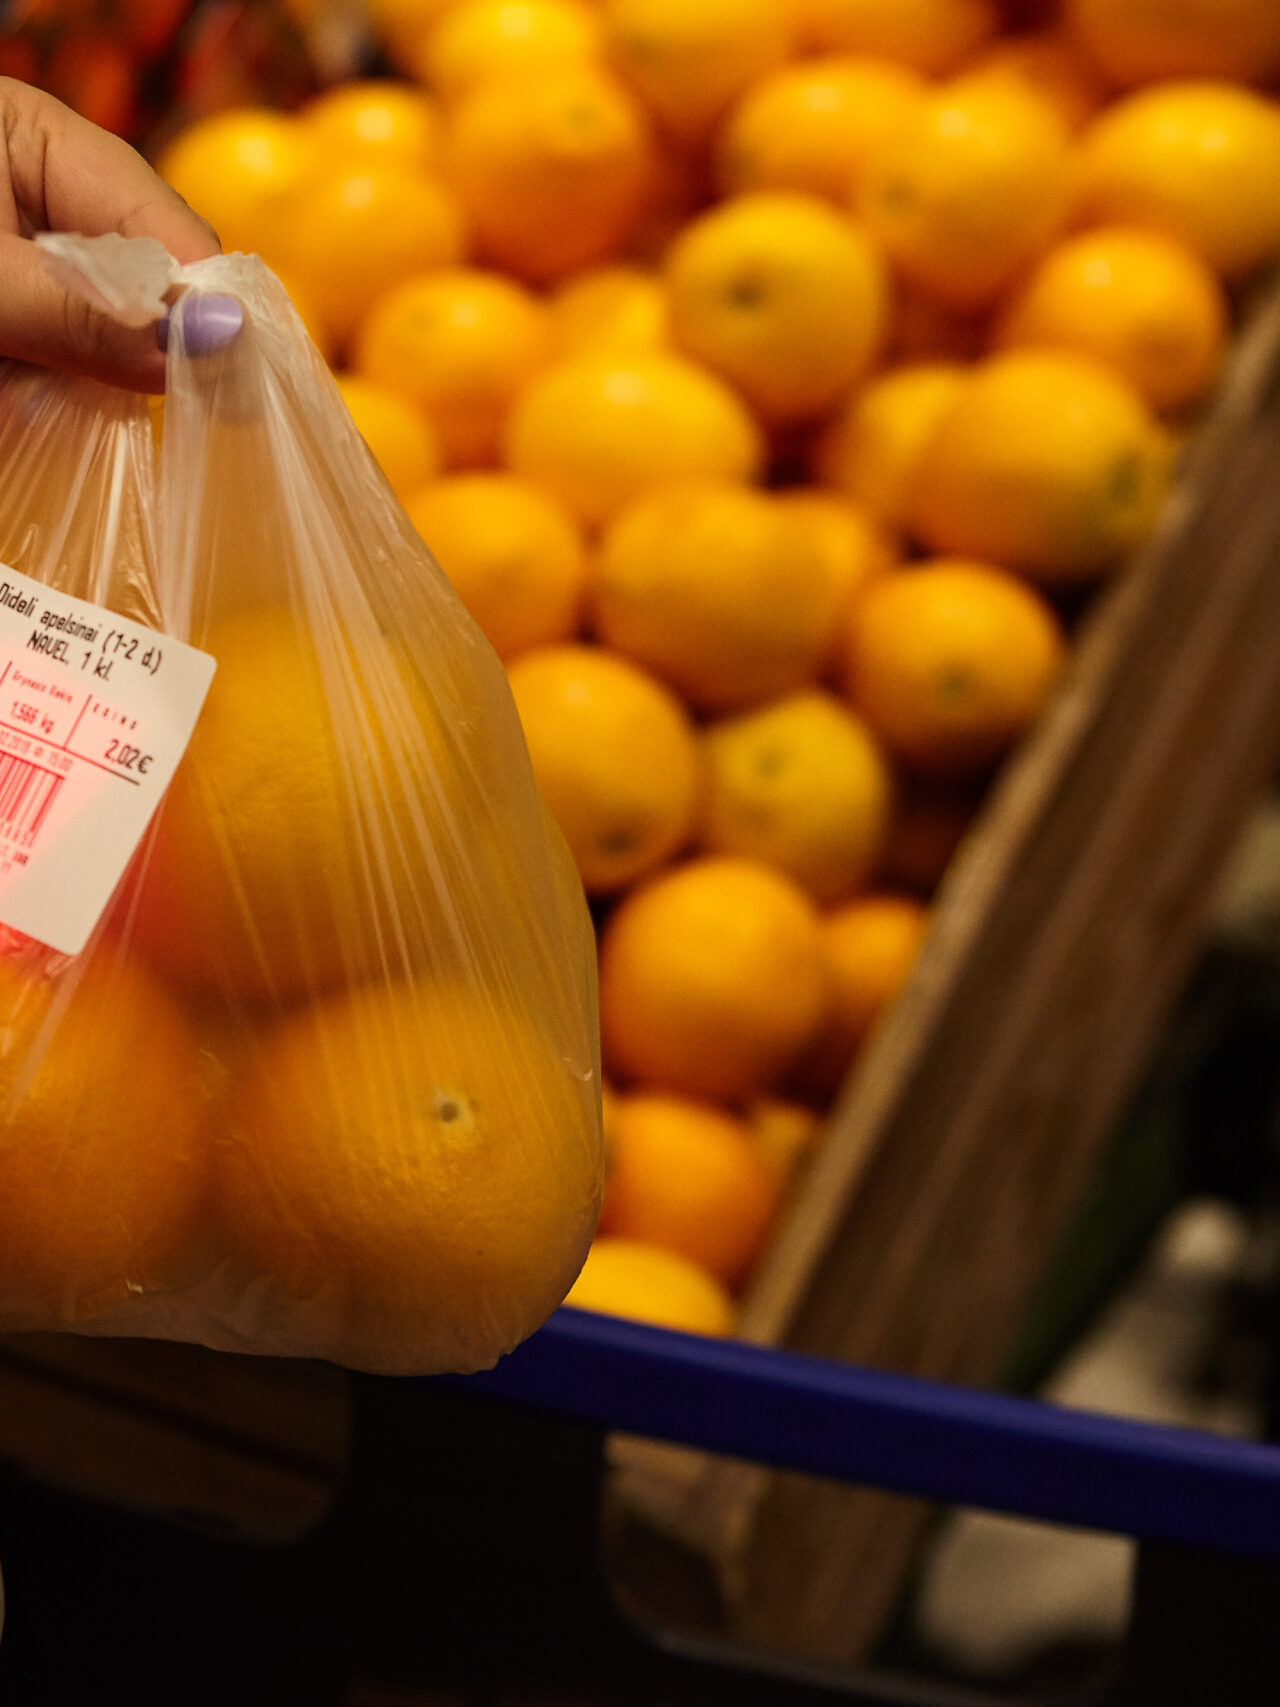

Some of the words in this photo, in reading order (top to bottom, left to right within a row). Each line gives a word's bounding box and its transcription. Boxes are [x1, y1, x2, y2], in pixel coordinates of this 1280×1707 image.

[39, 609, 101, 643] apelsinai
[101, 629, 139, 660] (1-2
[140, 647, 162, 675] d.)
[81, 651, 91, 670] 1
[93, 656, 113, 680] kl.
[39, 714, 54, 734] kg
[103, 738, 153, 774] 2,02€
